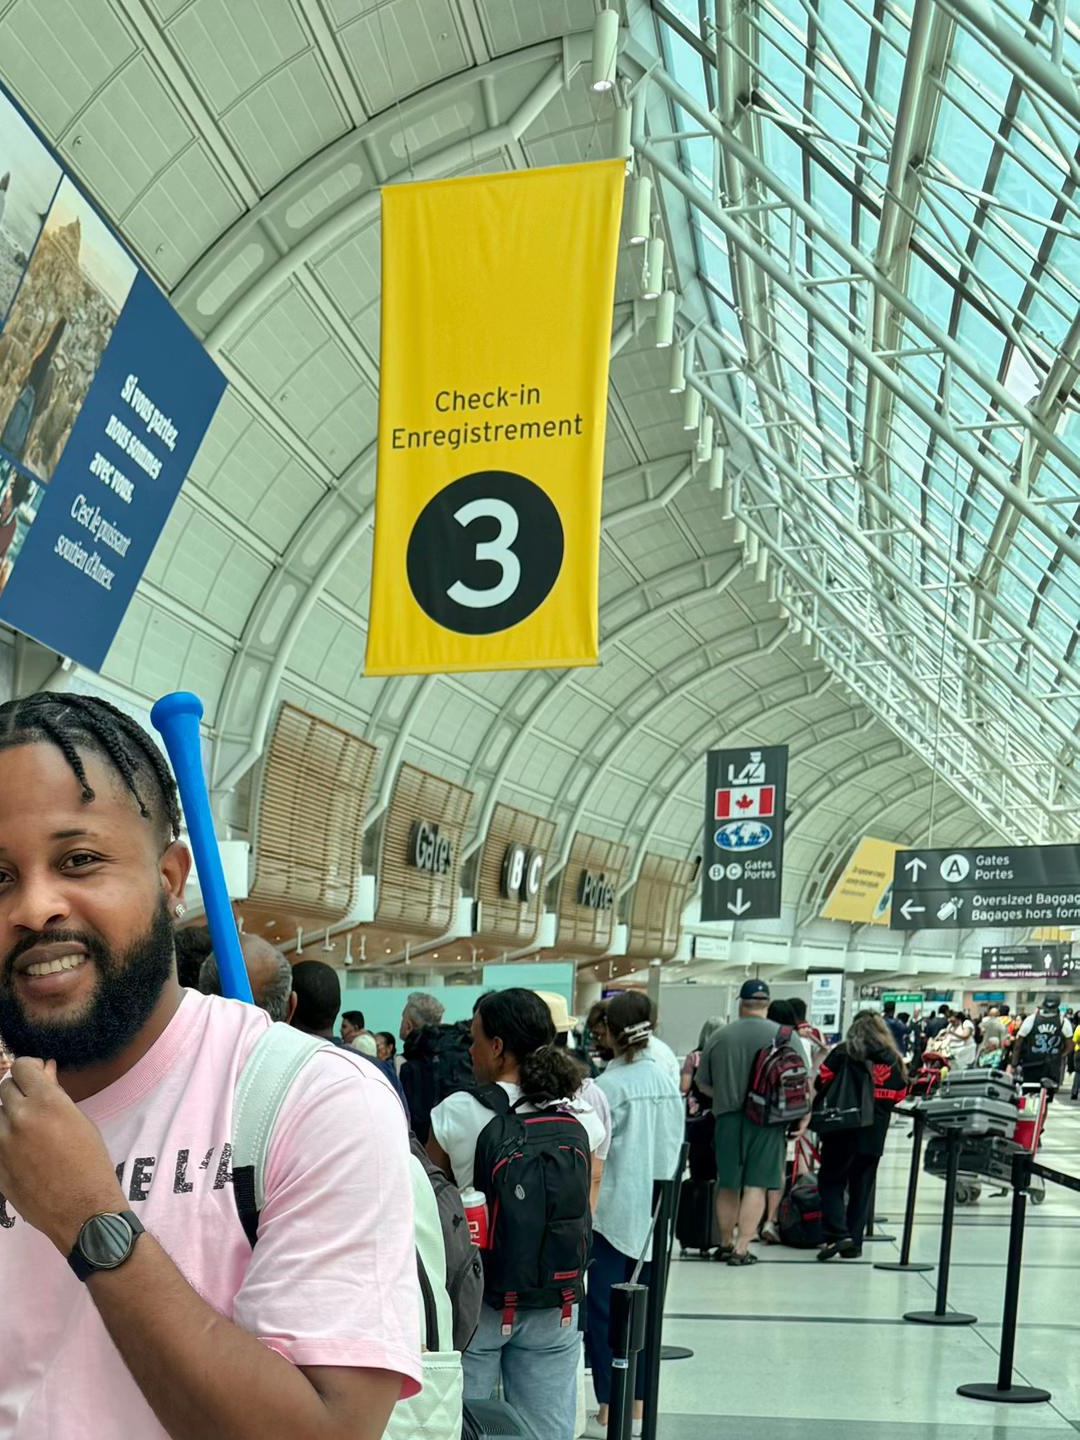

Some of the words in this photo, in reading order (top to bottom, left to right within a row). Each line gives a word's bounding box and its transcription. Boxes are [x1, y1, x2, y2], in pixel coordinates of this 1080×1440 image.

[120, 374, 138, 401] Si
[130, 387, 155, 424] vous
[435, 384, 541, 413] Check-in
[105, 414, 132, 450] nous
[125, 436, 163, 480] sommes
[392, 413, 584, 450] Enregistrement
[89, 452, 116, 486] avec
[54, 534, 88, 573] soutien
[94, 521, 132, 558] puissant
[446, 498, 521, 609] 3
[510, 849, 526, 890] B
[529, 854, 543, 895] C
[744, 860, 772, 870] Gates
[744, 869, 777, 880] Portes
[974, 868, 1014, 880] Portes
[975, 854, 1010, 866] Gates
[971, 907, 1023, 922] Bagages
[1025, 907, 1052, 919] hors
[972, 893, 1033, 907] Oversized
